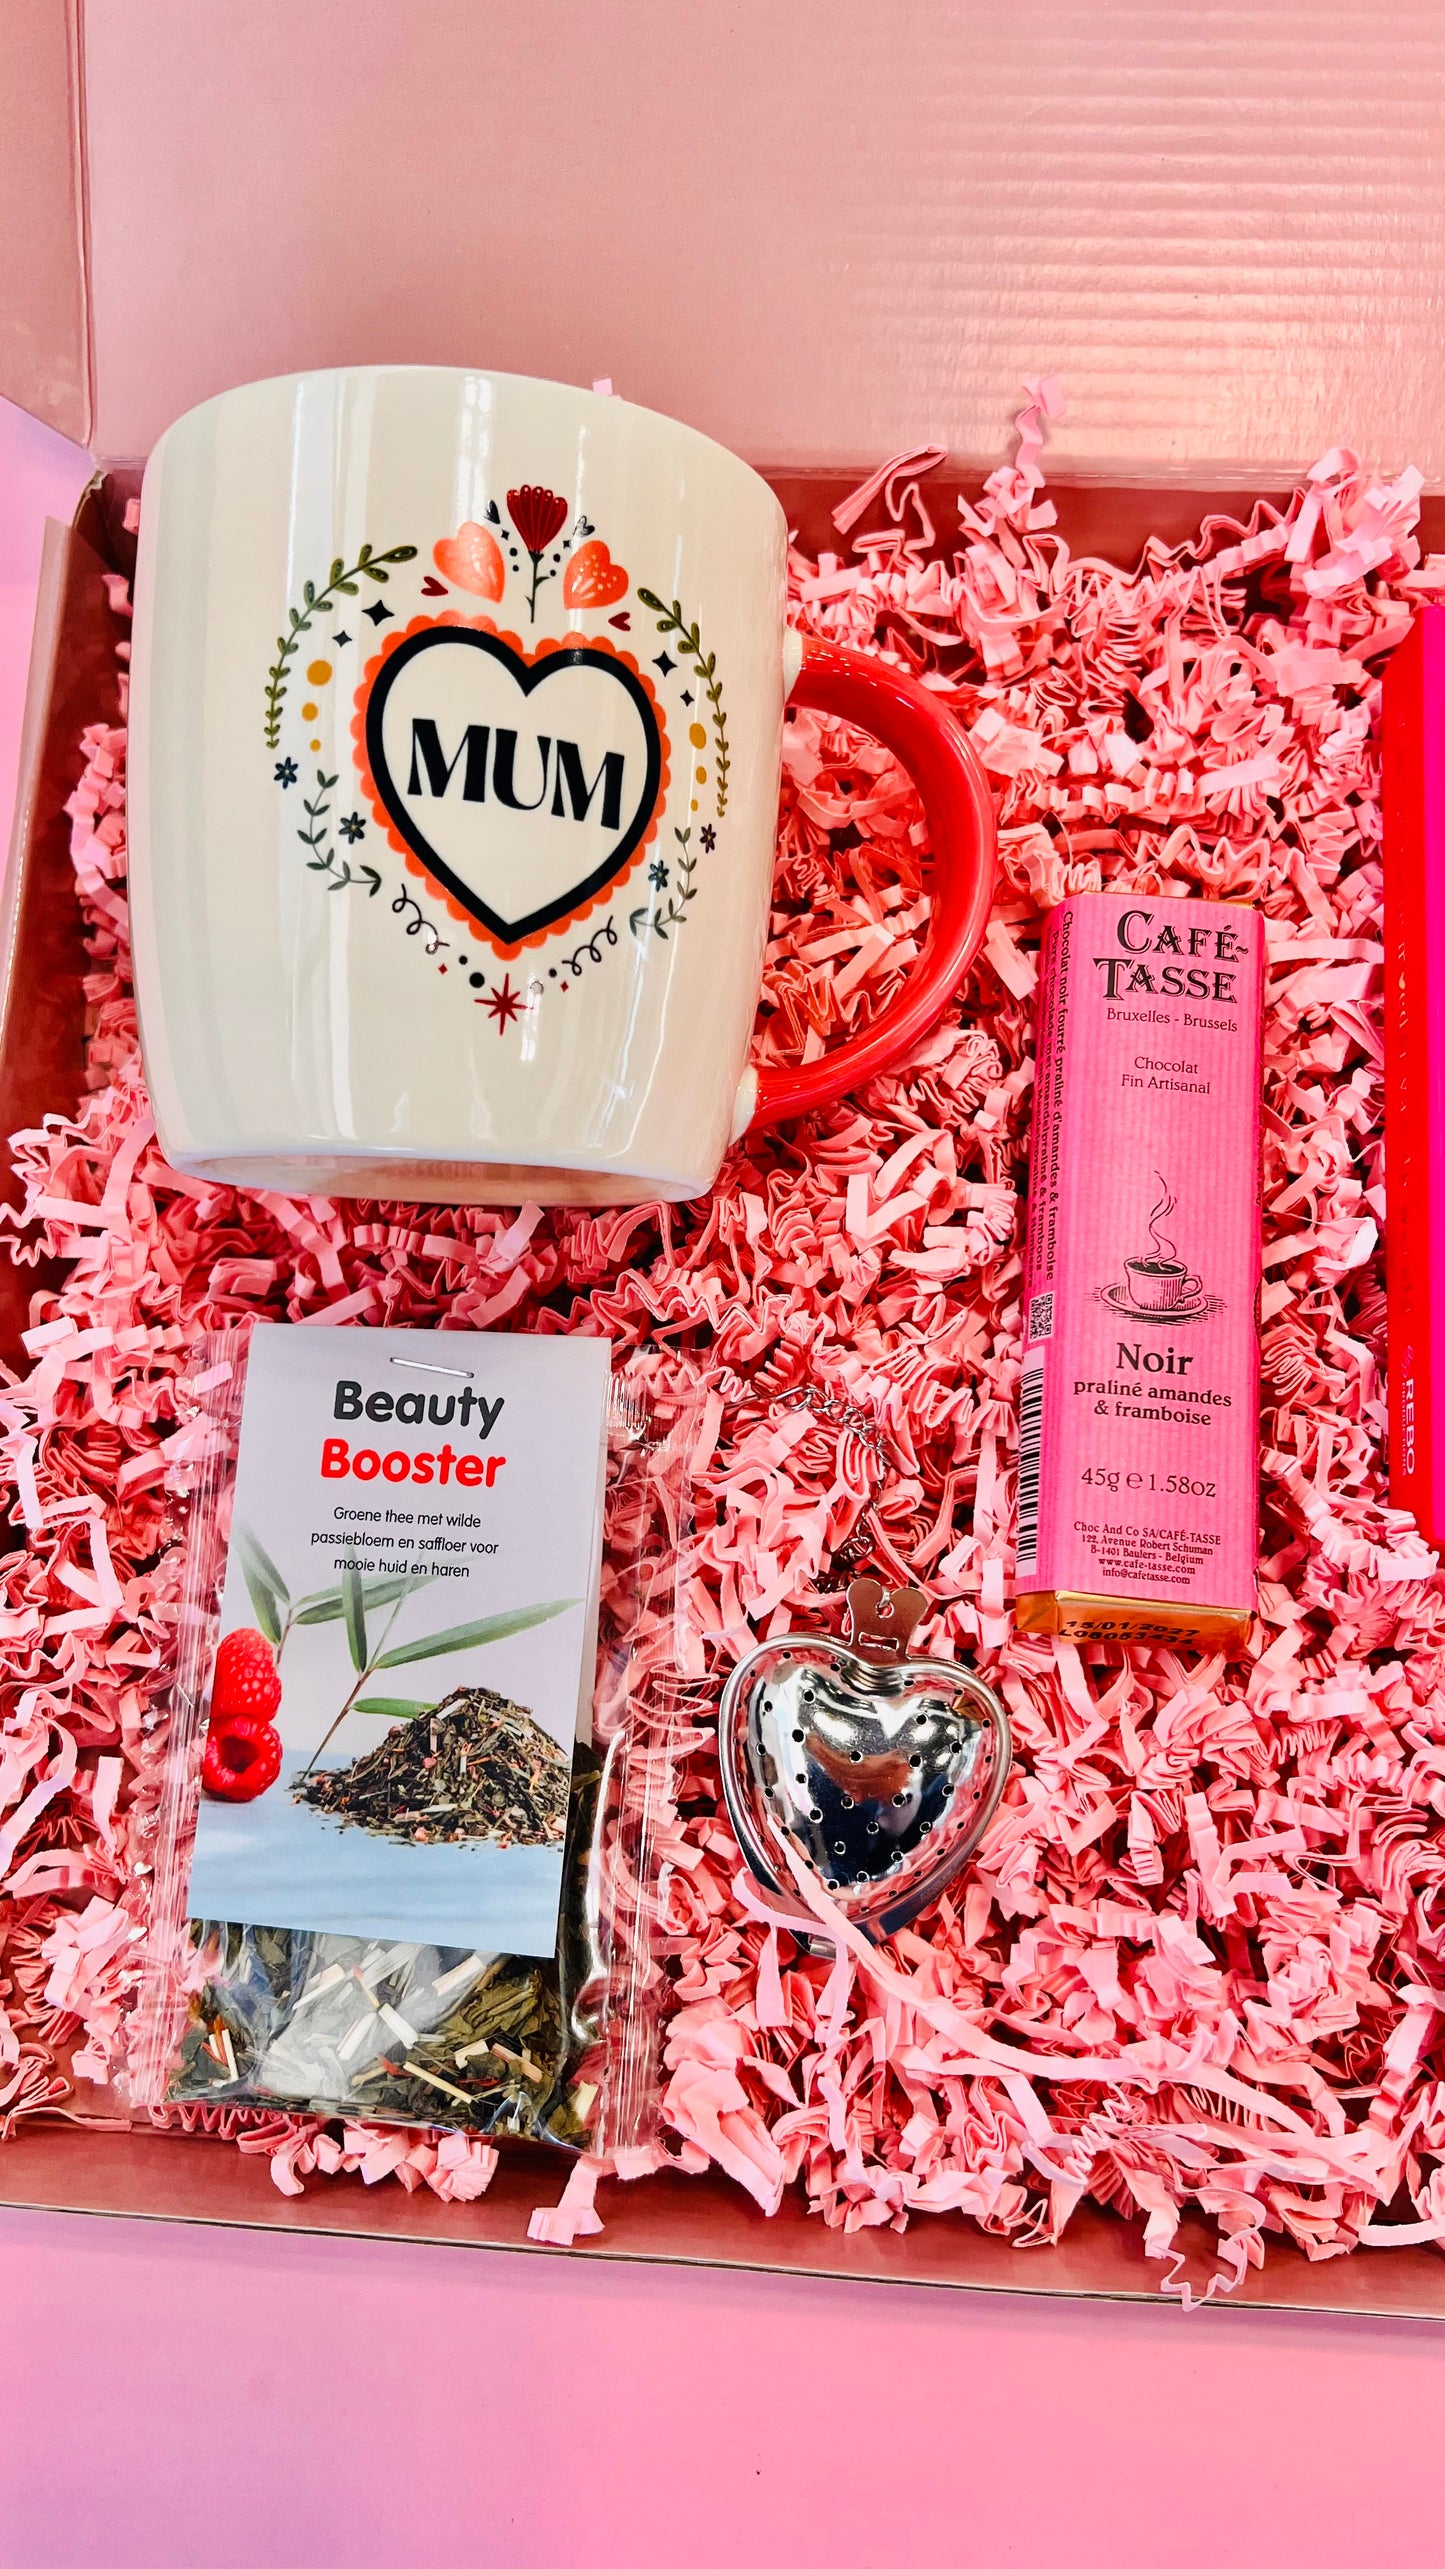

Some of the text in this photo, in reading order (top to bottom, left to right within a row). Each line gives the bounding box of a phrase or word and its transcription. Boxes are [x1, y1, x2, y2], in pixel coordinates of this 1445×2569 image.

[407, 718, 625, 830] MUM
[1051, 930, 1059, 965] Pure
[1093, 958, 1238, 1003] TASSE
[1047, 967, 1057, 1037] chocolade
[1107, 1008, 1170, 1024] Bruxelles
[1183, 1014, 1238, 1032] Brussels
[1134, 1056, 1199, 1075] Chocolat
[1046, 911, 1073, 1280] Chocolat noir fourré praliné d'amandes & framboise
[1121, 1074, 1211, 1095] Fin Artisanal
[1036, 1201, 1046, 1271] framboos
[1116, 1343, 1193, 1375] Noir
[1073, 1380, 1232, 1407] praliné amandes
[333, 1380, 505, 1440] Beauty
[1094, 1400, 1211, 1426] & framboise
[1406, 1378, 1415, 1475] REBO
[320, 1438, 507, 1488] Booster
[1081, 1468, 1120, 1492] 45g
[1148, 1473, 1216, 1498] 1.58oz
[334, 1506, 481, 1528] Groene thee met wilde
[311, 1531, 499, 1554] passiebloem en saffloer voor
[1074, 1521, 1221, 1545] Choc And Co SA/CAFÉ-TASSE
[1101, 1535, 1137, 1547] Avenue
[1140, 1539, 1170, 1550] Robert
[1173, 1542, 1213, 1555] Schuman
[334, 1558, 470, 1577] mooie huid en haren
[1090, 1545, 1120, 1555] B-1401
[1123, 1548, 1156, 1559] Baulers
[1165, 1552, 1204, 1565] Belgium
[1098, 1558, 1196, 1574] www.cafe-tasse.com
[1102, 1567, 1190, 1585] info@cafetasse.com
[1066, 1621, 1200, 1637] 15/01/2027
